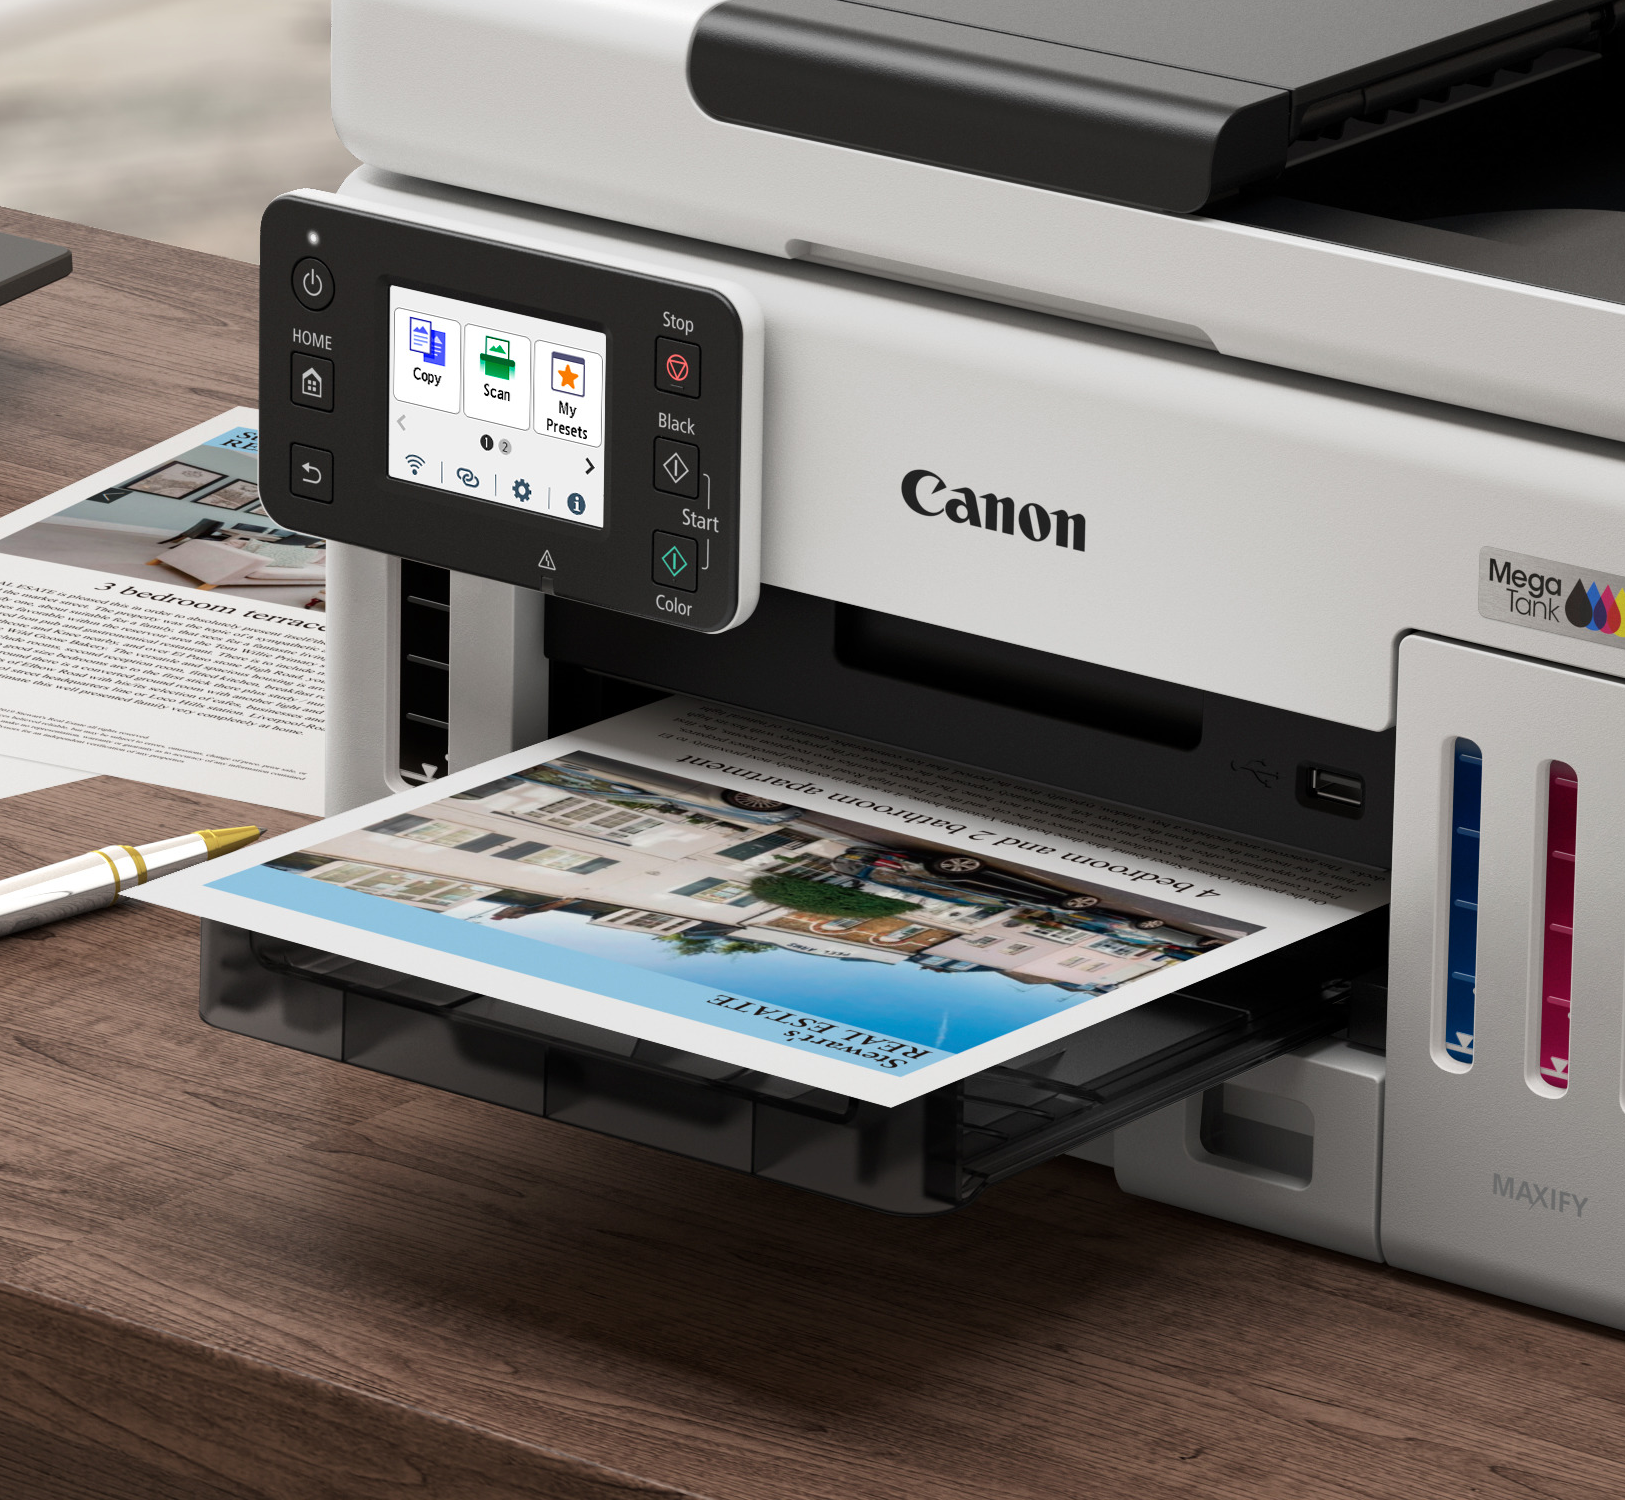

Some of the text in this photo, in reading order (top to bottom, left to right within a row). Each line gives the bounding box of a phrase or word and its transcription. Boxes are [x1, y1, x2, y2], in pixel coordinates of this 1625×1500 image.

[662, 311, 694, 334] Stop
[292, 327, 332, 351] HOME
[413, 366, 442, 388] Copy
[483, 382, 510, 403] Scan
[558, 400, 578, 419] My
[658, 411, 696, 436] Black
[546, 417, 588, 441] Presets
[682, 507, 719, 535] Start
[901, 469, 1087, 552] Canon
[1487, 557, 1562, 602] Mega
[94, 582, 117, 591] 3
[121, 585, 236, 616] bedroom
[655, 594, 693, 618] Color
[1505, 587, 1560, 624] Tank
[675, 753, 1221, 899] 4 bedroom and 2 bathroom apartment
[707, 994, 933, 1060] REAL ESTATE
[783, 1030, 908, 1069] Stewart's
[1492, 1172, 1589, 1219] MAXIFY
